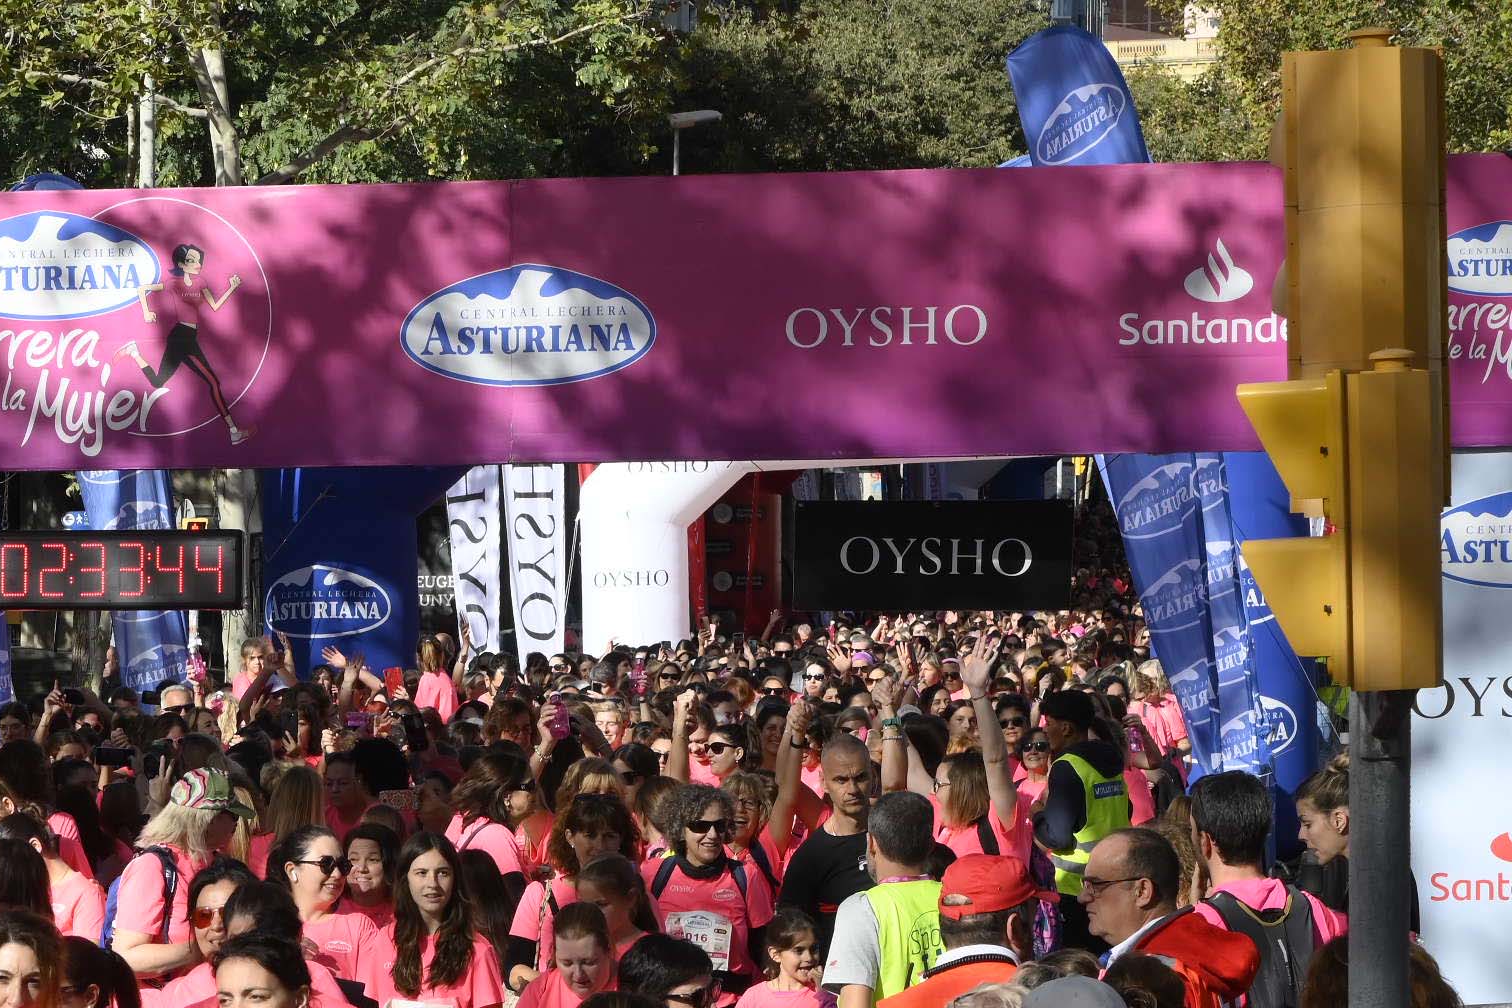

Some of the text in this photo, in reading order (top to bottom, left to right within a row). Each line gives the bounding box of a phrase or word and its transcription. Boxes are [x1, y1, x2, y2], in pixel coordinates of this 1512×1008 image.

[63, 247, 135, 258] LECHERA
[460, 305, 627, 320] CENTRAL LECHERA
[786, 304, 987, 348] OYSHO
[1118, 311, 1288, 345] Santande
[420, 311, 636, 356] ASTURIANA
[1, 372, 26, 411] la
[21, 363, 170, 457] Mujer
[0, 543, 222, 597] 02:33:44
[840, 536, 1033, 576] OYSHO
[593, 569, 669, 588] OYSHO
[269, 596, 381, 622] ASTURIANA
